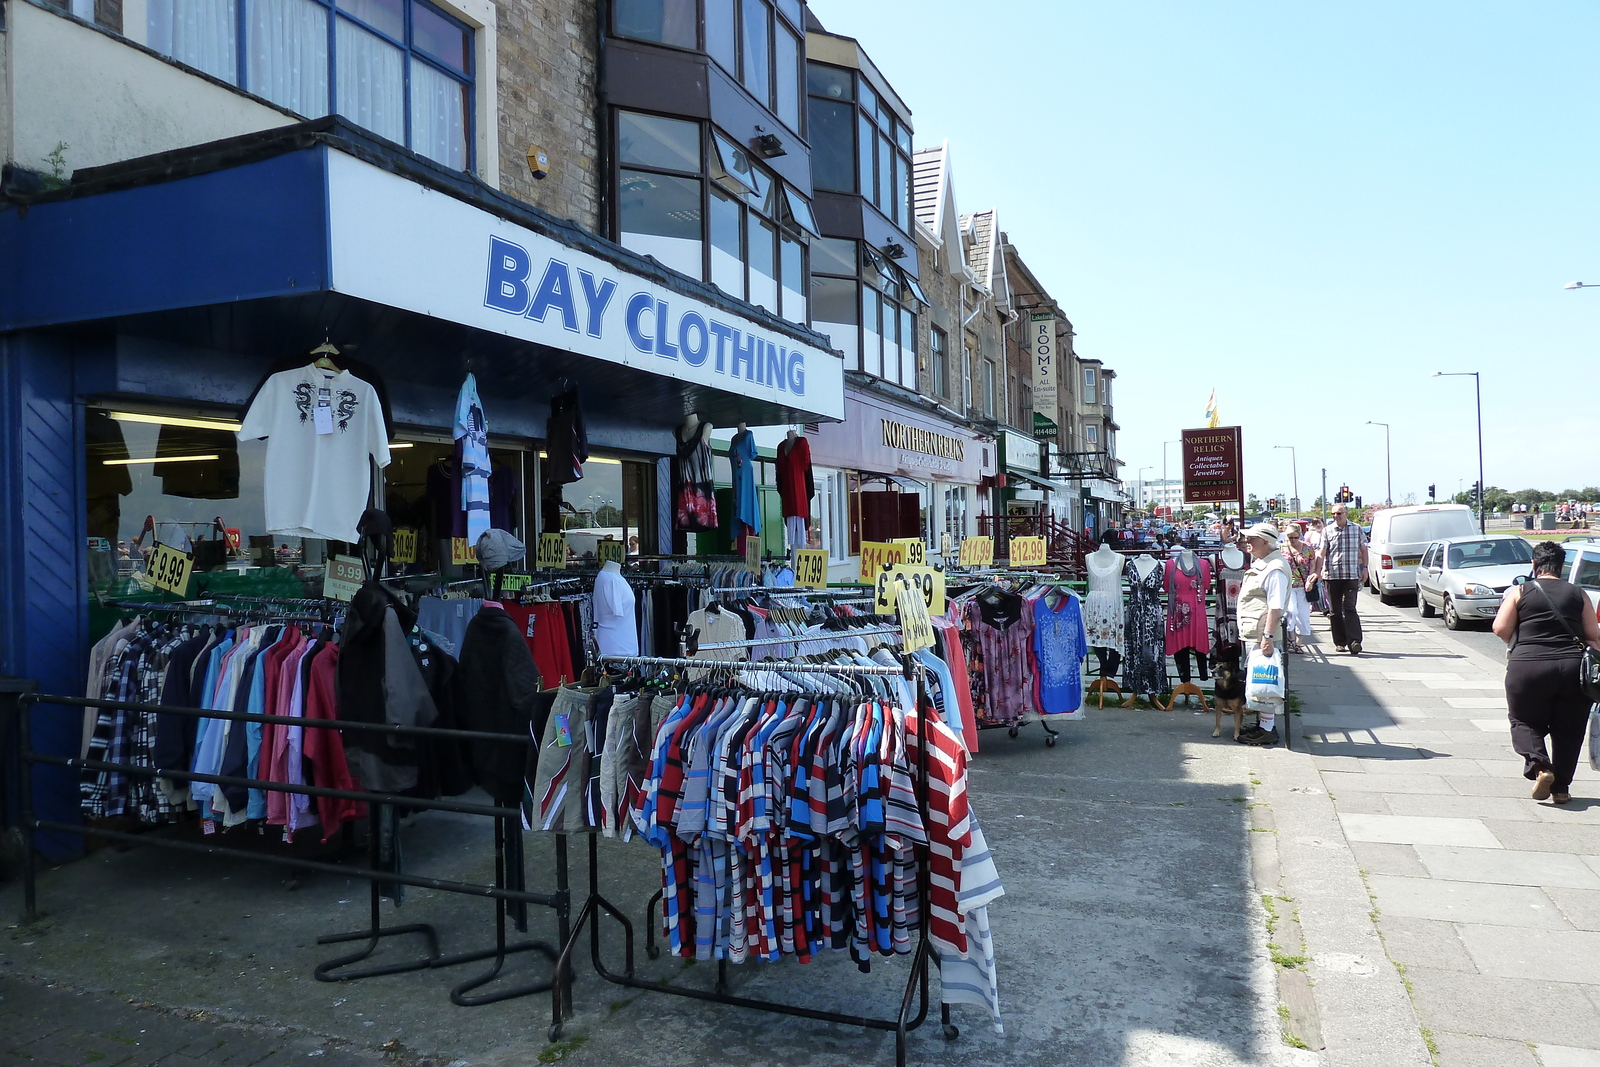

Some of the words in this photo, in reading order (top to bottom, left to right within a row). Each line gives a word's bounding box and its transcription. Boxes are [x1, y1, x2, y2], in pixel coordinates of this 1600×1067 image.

[483, 233, 618, 339] BAY
[625, 291, 805, 397] CLOTHING
[1037, 325, 1050, 375] ROOMS
[881, 418, 937, 456] NORTHERN
[937, 434, 964, 462] RELICS
[1034, 428, 1057, 436] 414488
[1185, 435, 1233, 444] NORTHERN
[1193, 445, 1225, 453] RELICS
[1217, 489, 1230, 497] 984
[538, 539, 563, 562] £10.99
[962, 540, 991, 561] £11.99
[1011, 540, 1043, 561] £12.99
[337, 564, 362, 580] 9.99
